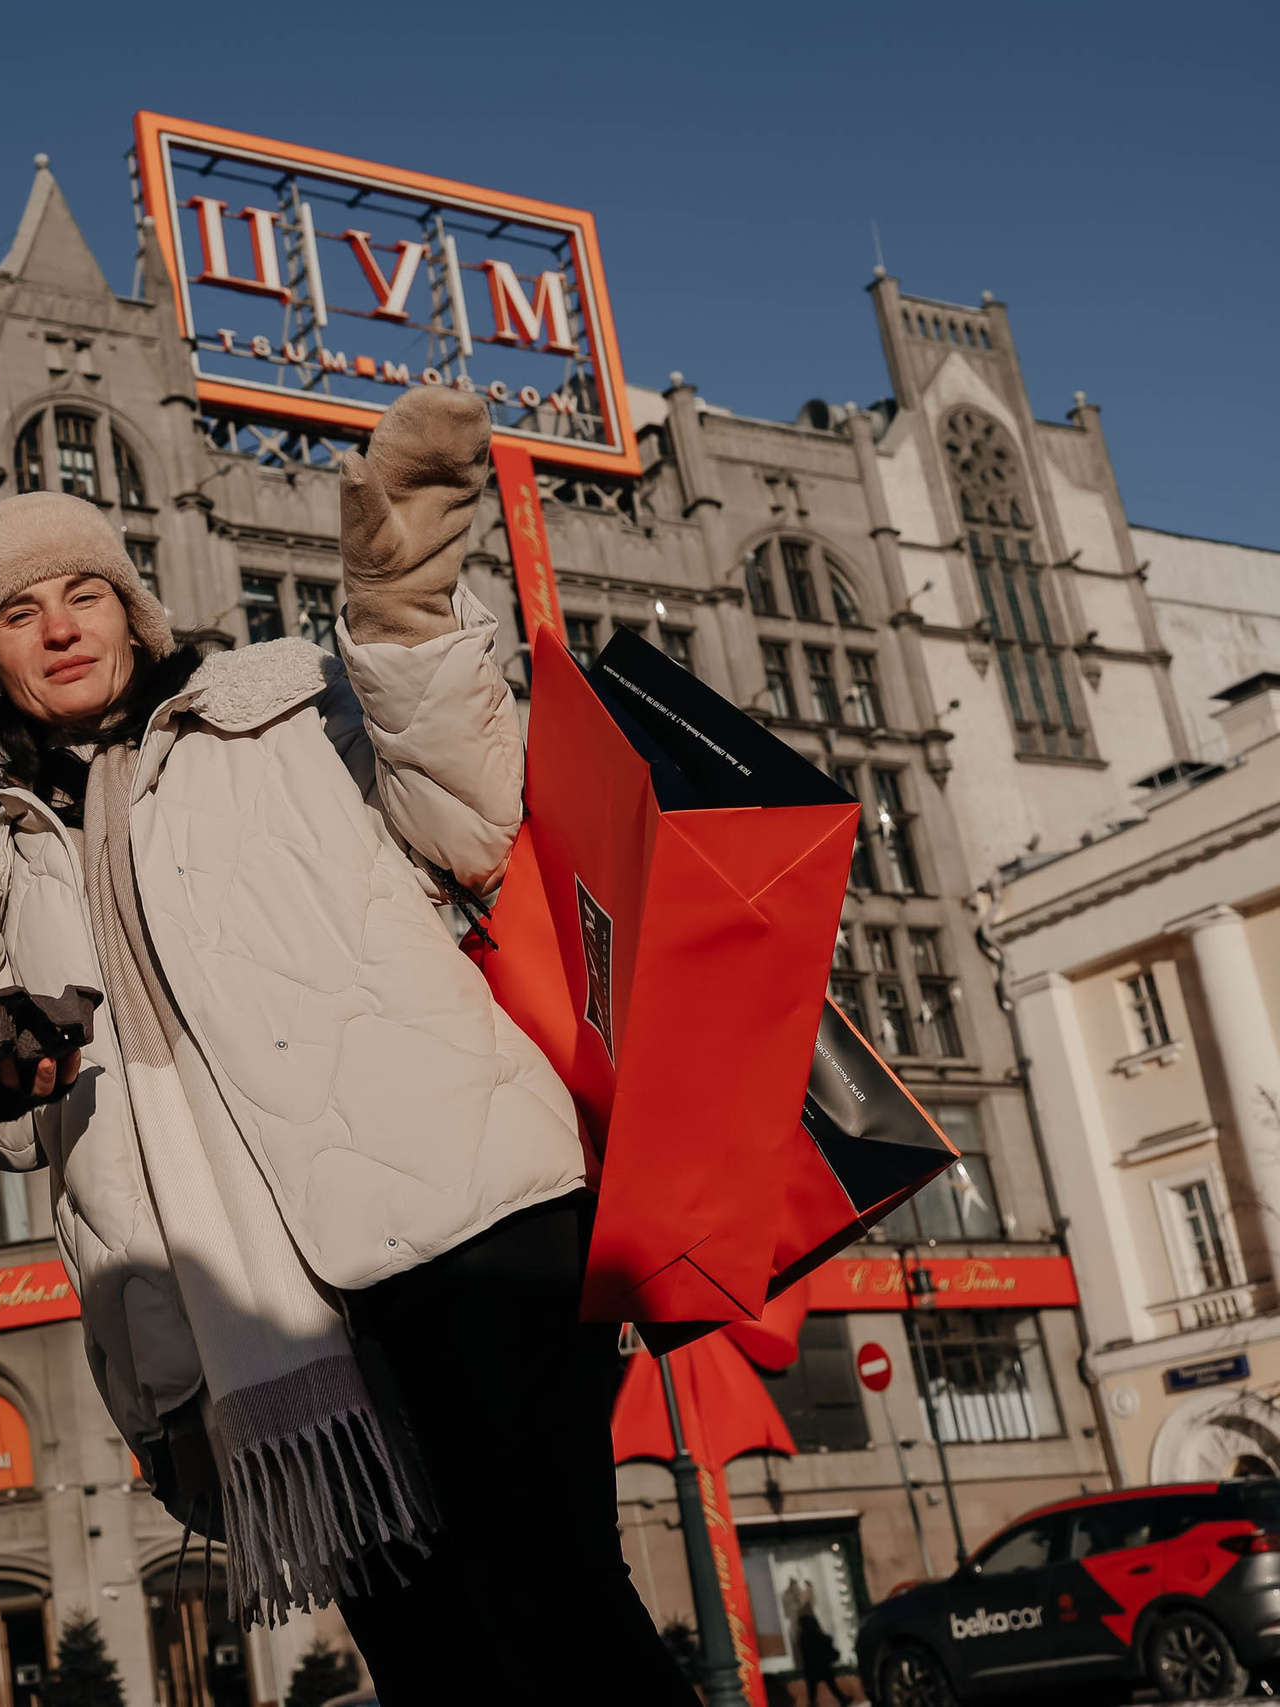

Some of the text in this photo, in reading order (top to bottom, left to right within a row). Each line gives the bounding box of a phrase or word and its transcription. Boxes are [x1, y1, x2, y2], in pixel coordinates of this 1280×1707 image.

[217, 328, 578, 414] TSUM MOSCOW
[815, 1038, 866, 1103] ЦУМ Россия, 12500
[950, 1604, 1044, 1640] belkacar
